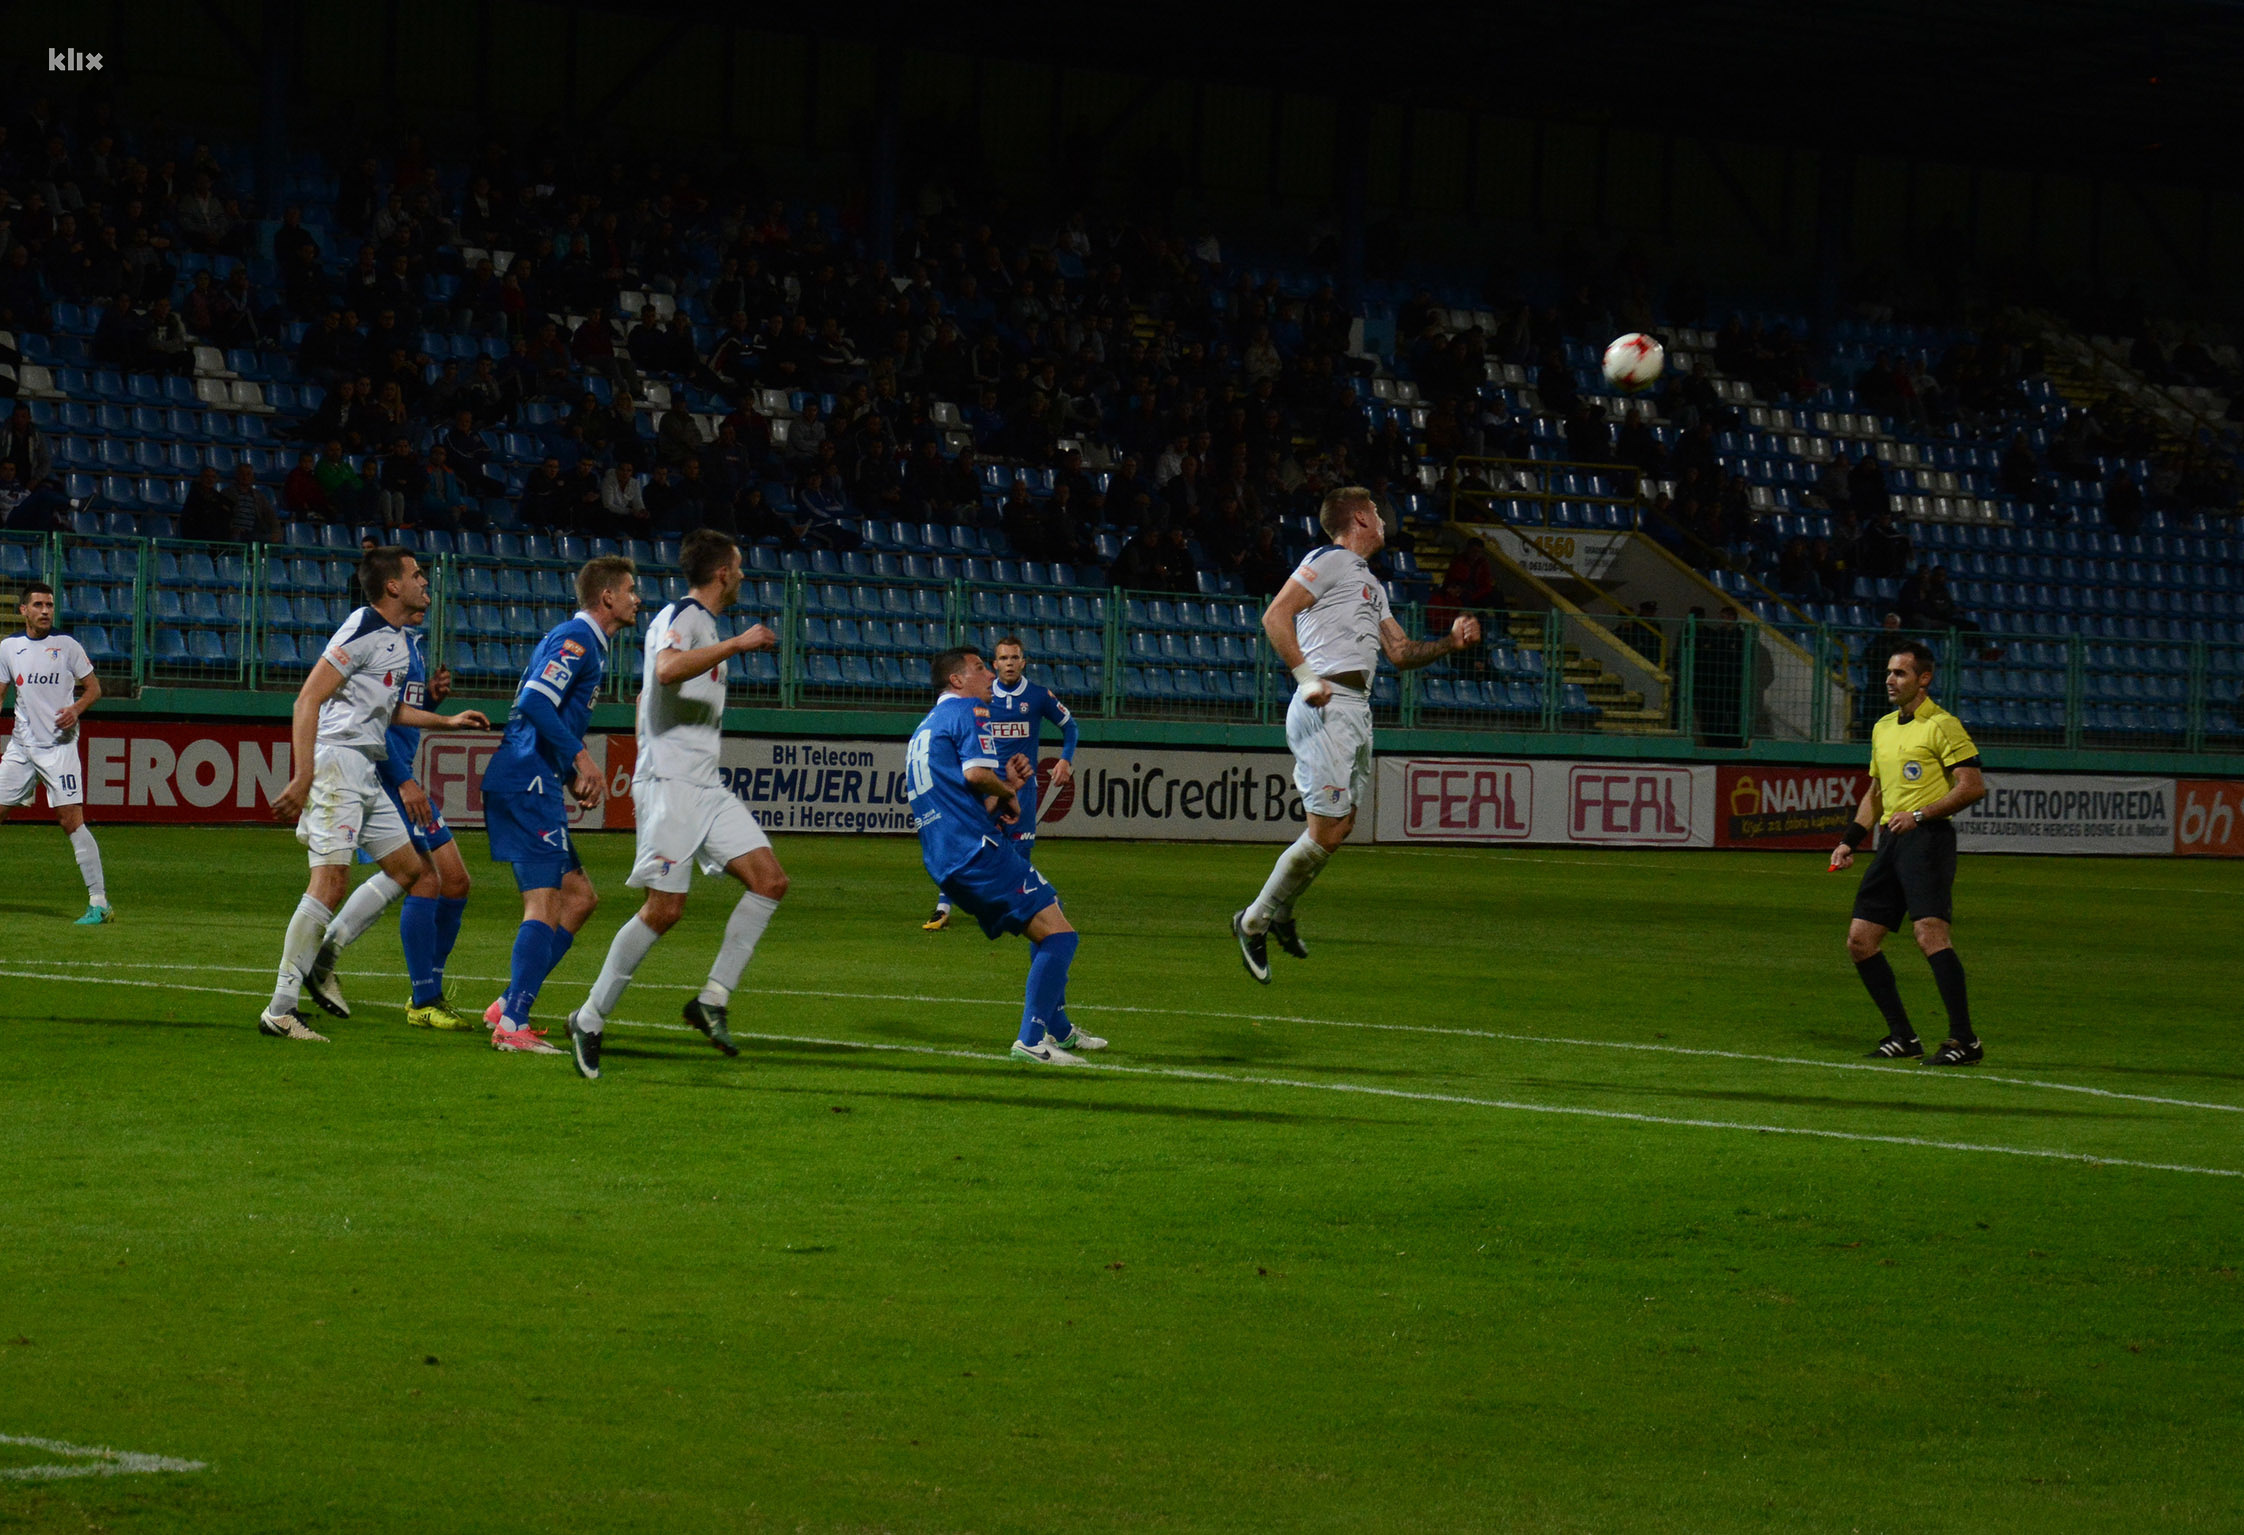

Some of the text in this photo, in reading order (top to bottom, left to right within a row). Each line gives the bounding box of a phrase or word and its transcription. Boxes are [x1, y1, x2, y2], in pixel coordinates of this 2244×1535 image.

[991, 723, 1029, 737] FEAL
[0, 733, 292, 808] ERON
[772, 744, 874, 767] BH Telecom
[59, 773, 77, 791] 10
[718, 767, 863, 804] PREMIJER
[1082, 762, 1259, 821] UniCredit
[1410, 769, 1526, 830] FEAL
[1761, 775, 1857, 814] NAMEX
[789, 806, 795, 827] i
[800, 806, 915, 832] Hercegovine
[1573, 774, 1687, 834] FEAL
[1970, 789, 2167, 820] ELEKTROPRIVREDA
